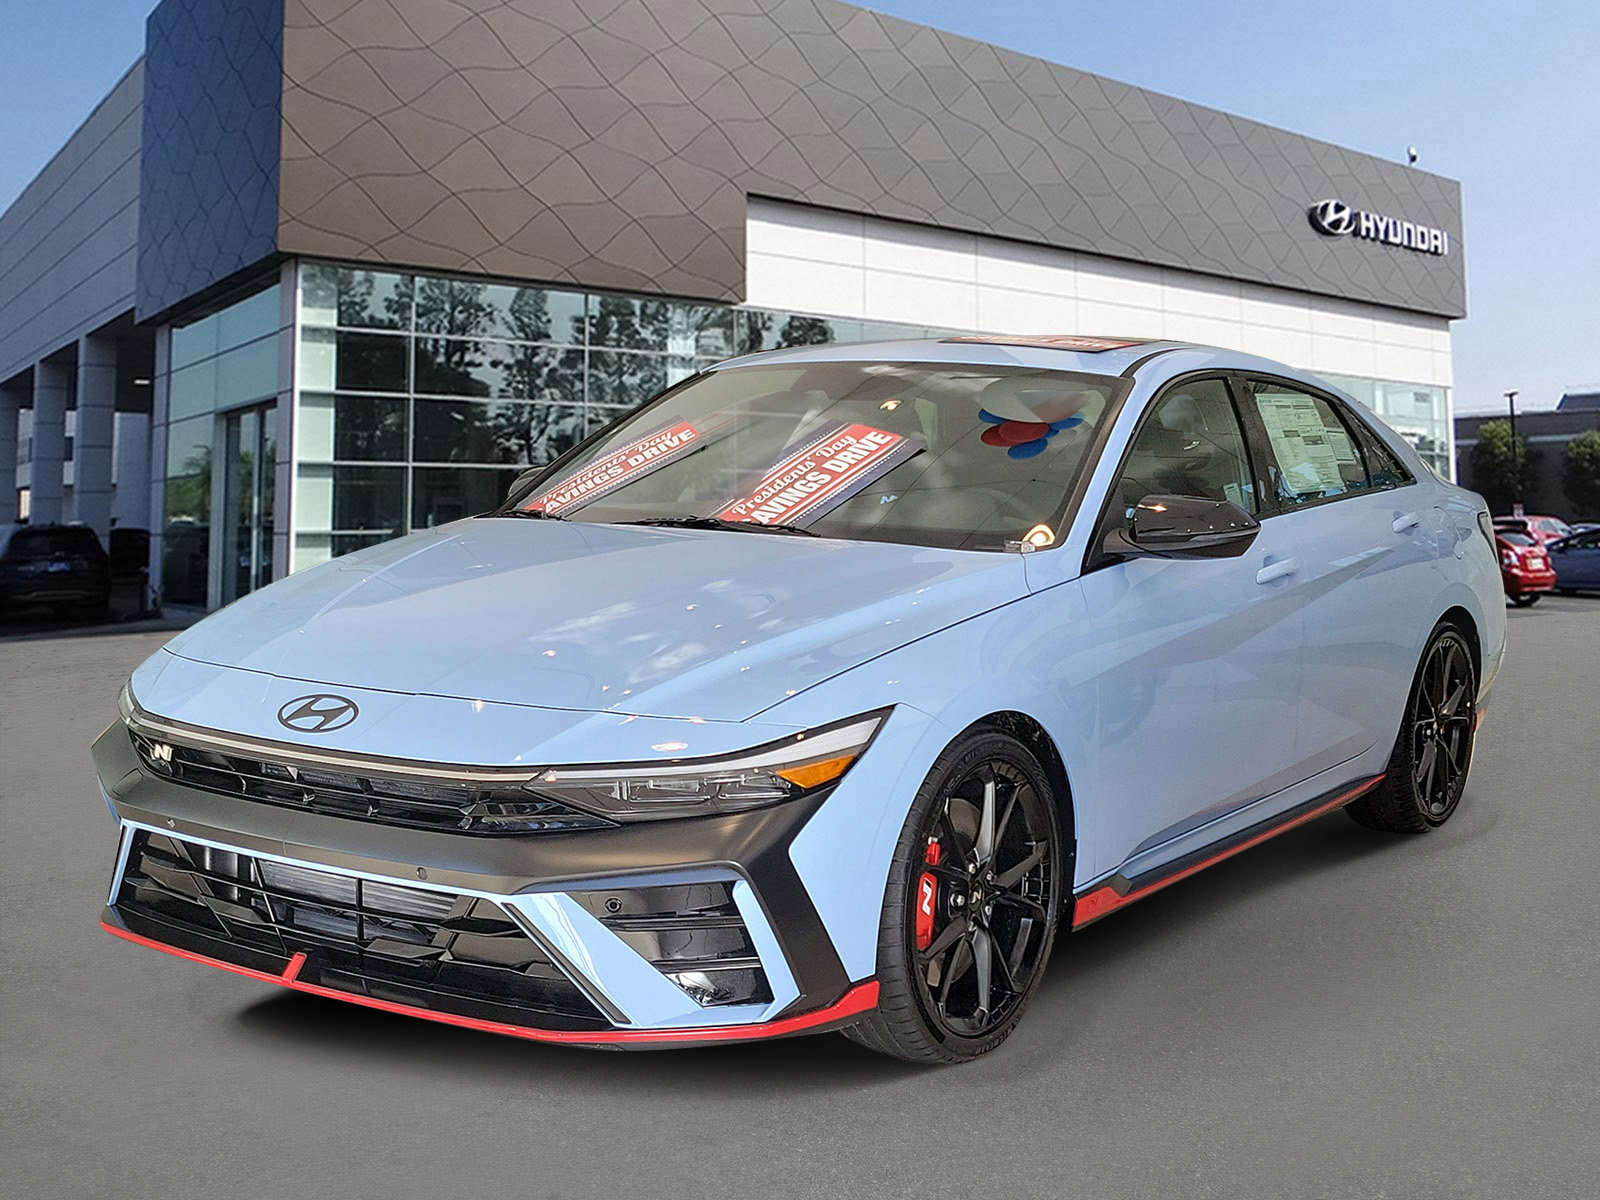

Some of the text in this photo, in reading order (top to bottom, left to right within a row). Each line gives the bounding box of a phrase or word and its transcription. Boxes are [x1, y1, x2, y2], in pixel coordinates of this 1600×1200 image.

[1359, 210, 1449, 256] HYUNDAI
[538, 428, 697, 514] AVINGS DRIVE
[633, 431, 673, 453] Day
[731, 434, 858, 515] Presidents' Day
[741, 430, 893, 525] AVINGS DRIVE
[153, 743, 173, 762] N
